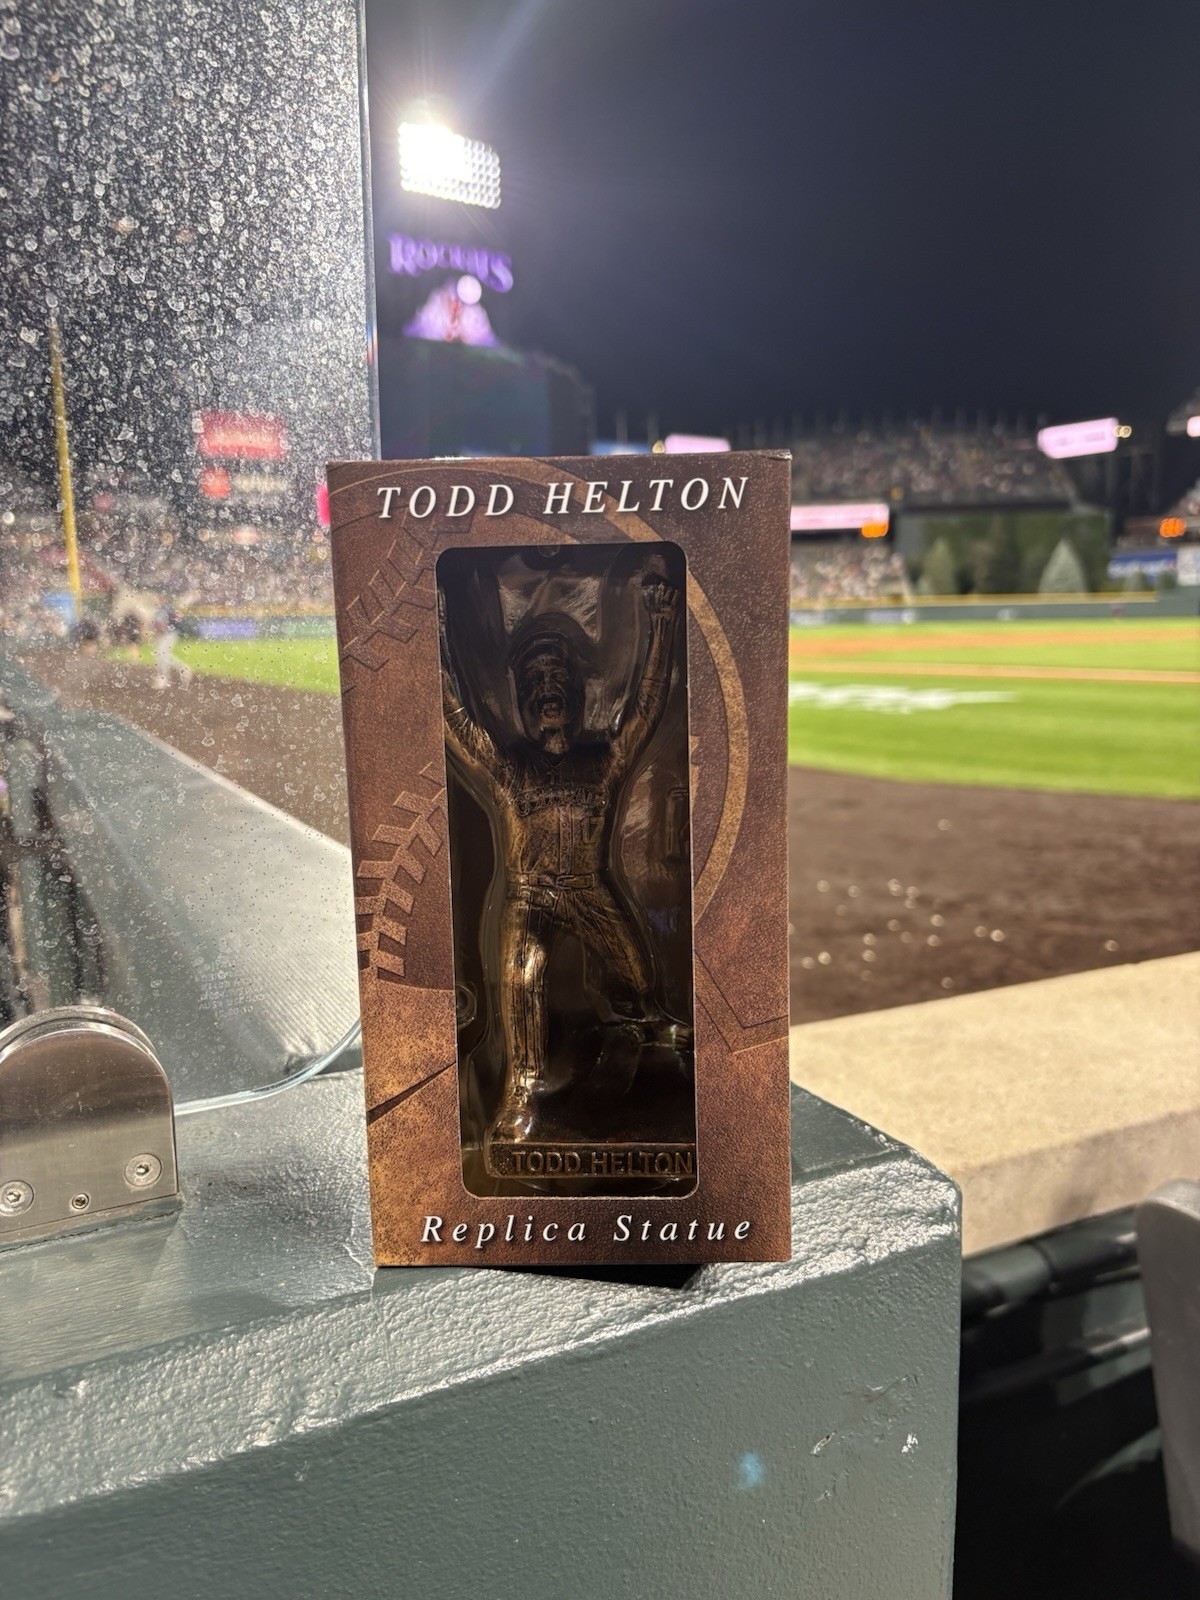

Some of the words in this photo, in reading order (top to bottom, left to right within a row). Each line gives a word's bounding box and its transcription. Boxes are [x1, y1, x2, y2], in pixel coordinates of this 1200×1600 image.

[377, 484, 515, 519] TODD
[543, 477, 749, 514] HELTON
[580, 816, 606, 844] 17
[511, 1151, 581, 1173] TODD
[591, 1151, 693, 1174] HELTON
[420, 1215, 587, 1248] Replica
[614, 1214, 751, 1242] Statue
